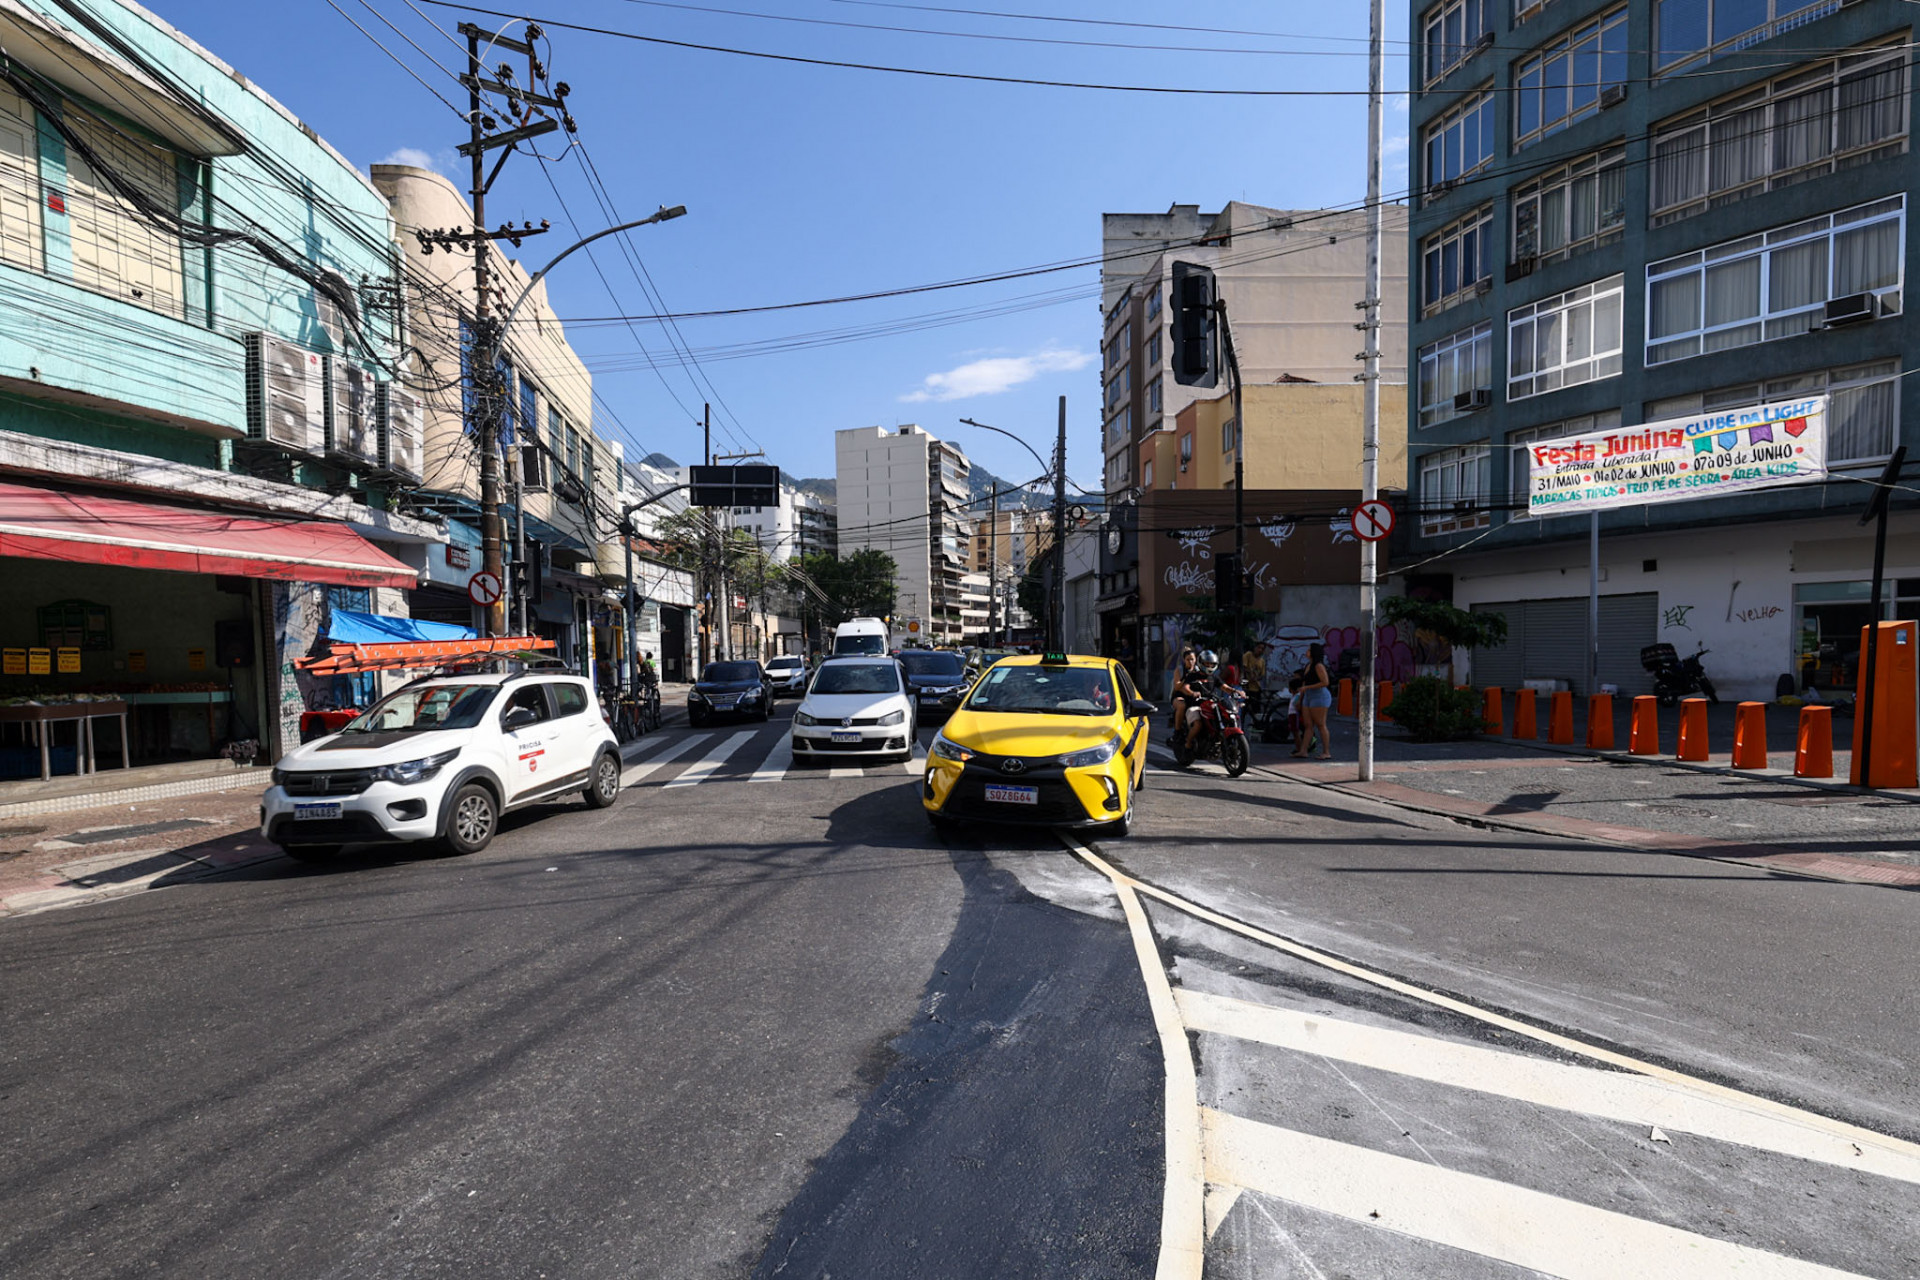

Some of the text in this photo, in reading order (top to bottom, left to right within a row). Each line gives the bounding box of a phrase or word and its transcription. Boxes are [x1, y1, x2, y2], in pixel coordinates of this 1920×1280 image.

[1686, 400, 1818, 436] CLUBE DA LIGHT
[1533, 428, 1684, 466] Festa Junina
[1532, 461, 1798, 506] BARRACAS TÍPICAS TRIO PÉ DE SERRA ÁREA KIDS
[1538, 474, 1580, 490] 31/MAIO
[1625, 468, 1637, 479] de
[1640, 461, 1676, 478] JUNHO
[1694, 456, 1706, 471] 07
[1716, 452, 1732, 468] 09
[1734, 452, 1747, 466] de
[1750, 444, 1792, 463] JUNHO
[1555, 461, 1595, 474] Entrada
[1046, 652, 1064, 660] TAXI
